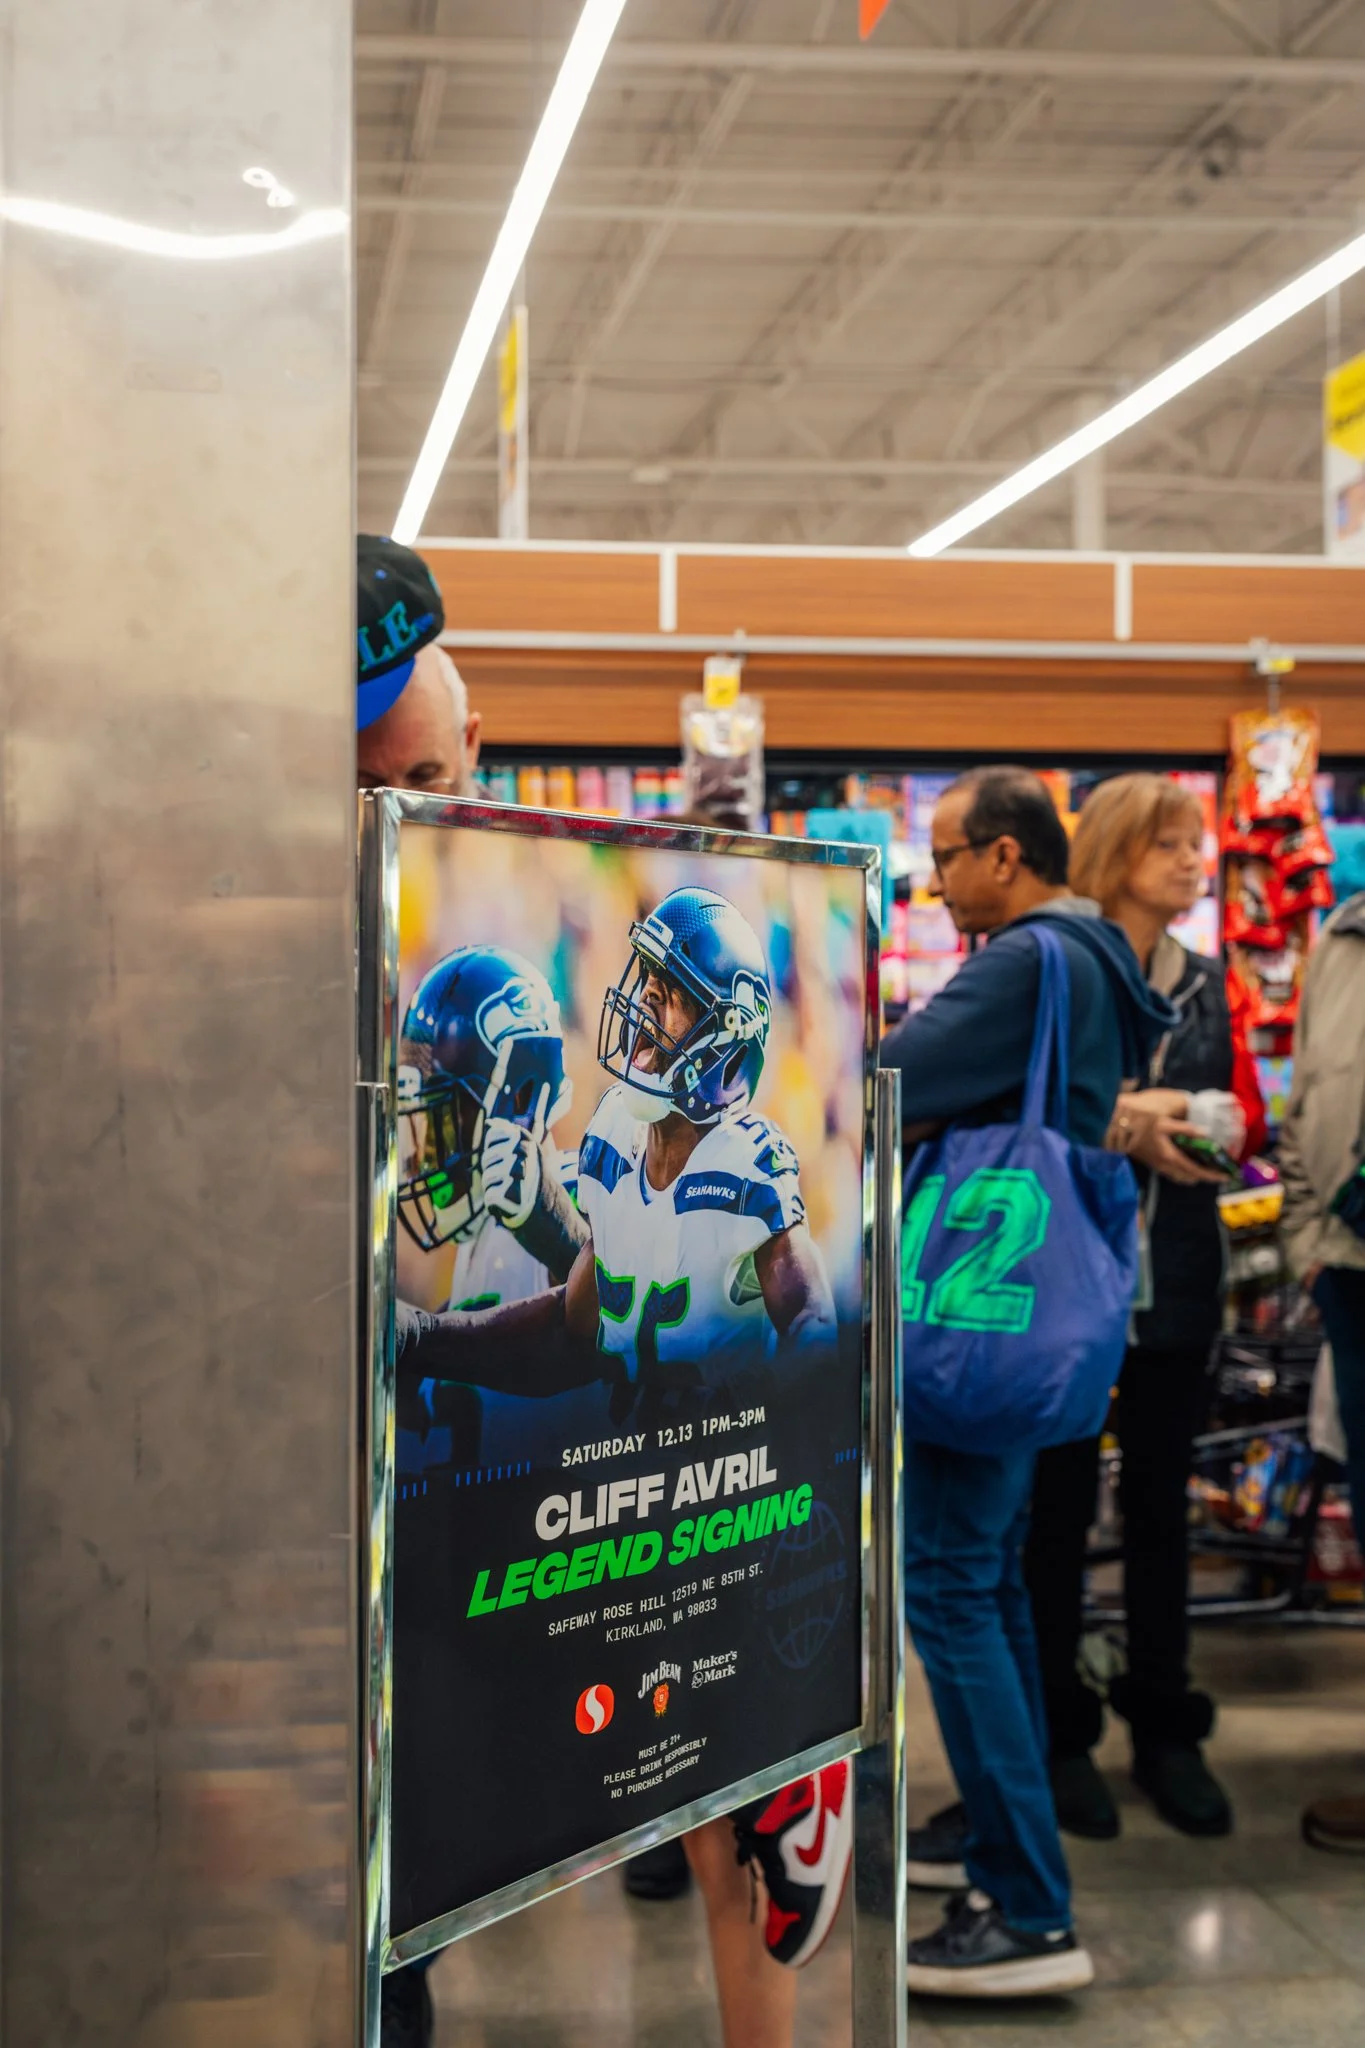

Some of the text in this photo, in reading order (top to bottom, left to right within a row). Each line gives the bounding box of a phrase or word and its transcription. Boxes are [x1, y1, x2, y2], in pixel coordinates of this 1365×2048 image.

[685, 1186, 736, 1200] SEAHAWKS
[901, 1167, 1052, 1334] 12
[562, 1434, 646, 1467] SATURDAY
[657, 1423, 694, 1447] 12.13
[536, 1446, 777, 1540] CLIFF AVRIL
[468, 1484, 812, 1617] LEGEND SIGNING
[549, 1563, 762, 1636] SAFEWAY ROSE HILL 12519 NE 85TH ST.
[606, 1598, 716, 1642] KIRKLAND, WA 98033
[637, 1660, 682, 1699] JIM BEAM
[692, 1651, 737, 1672] Maker's
[704, 1666, 735, 1683] Mark
[604, 1737, 706, 1784] PLEASE DRINK RESPONSIBLY
[639, 1734, 680, 1759] MUST BE 21+
[611, 1755, 699, 1798] NO PURCHASE NECESSARY
